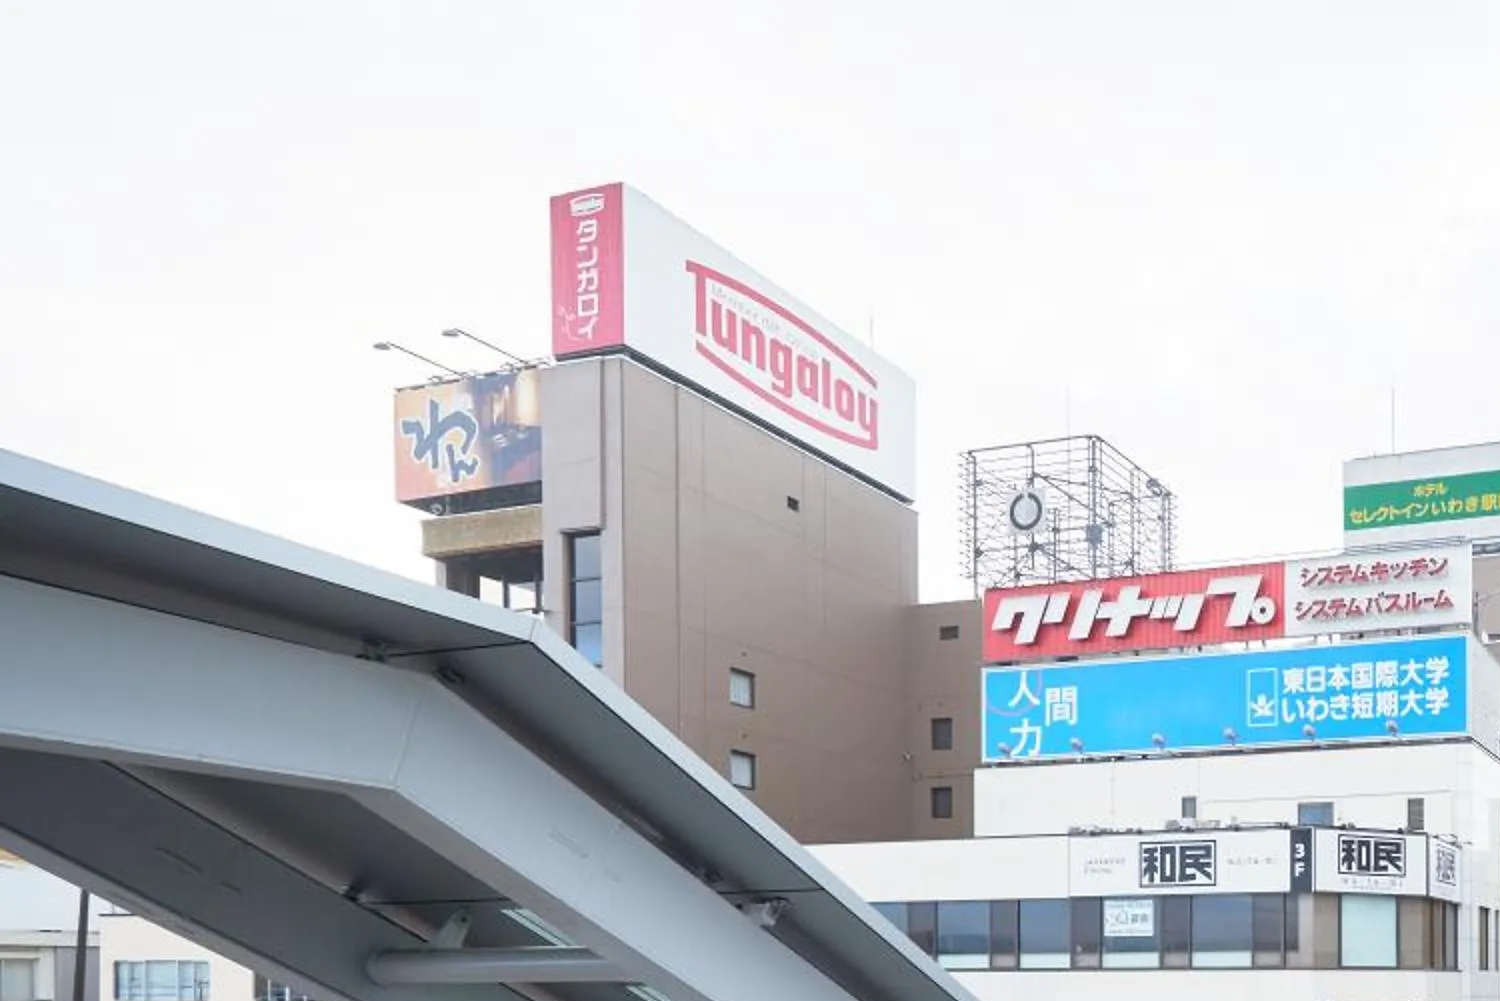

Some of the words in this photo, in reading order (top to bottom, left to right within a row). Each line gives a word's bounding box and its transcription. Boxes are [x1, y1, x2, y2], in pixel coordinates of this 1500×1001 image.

[575, 219, 599, 340] タンガロイ
[685, 258, 878, 451] Tungaloy
[401, 398, 479, 483] わん
[1410, 480, 1449, 498] ホテル
[1300, 556, 1450, 588] システムキッチン
[991, 576, 1277, 645] クリナップ
[1295, 588, 1455, 623] システムバスルーム
[1281, 654, 1450, 695] 東日本国際大学
[1281, 686, 1450, 724] いわき短期大学
[1142, 844, 1213, 883] 和民
[1341, 838, 1403, 873] 和民
